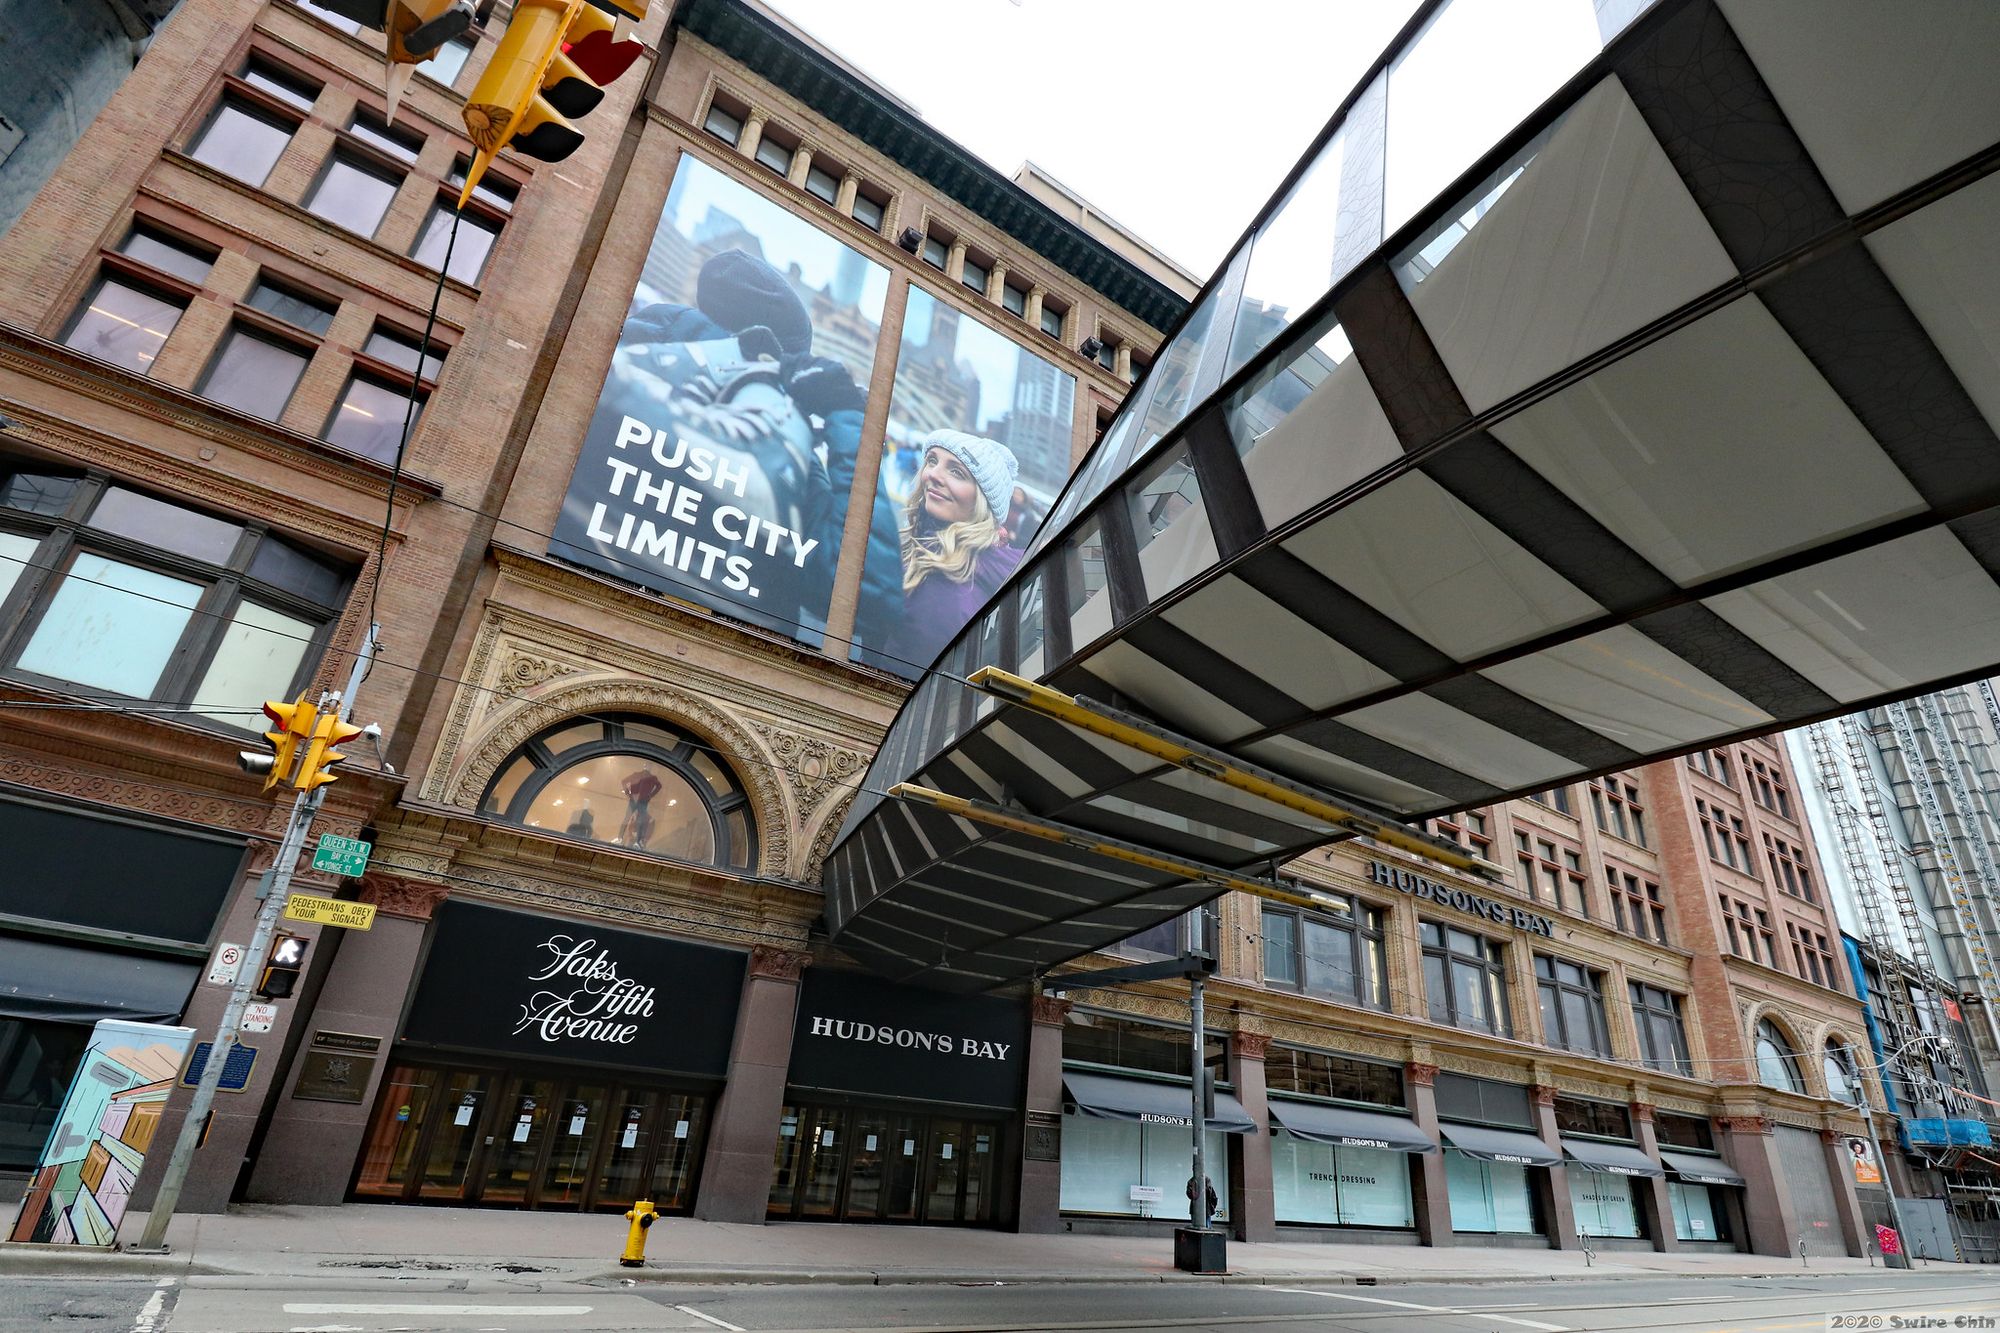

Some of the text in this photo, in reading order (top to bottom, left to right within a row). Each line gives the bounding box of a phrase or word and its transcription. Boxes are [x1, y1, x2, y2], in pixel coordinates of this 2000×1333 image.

[614, 415, 750, 498] PUSH
[606, 456, 819, 568] THE CITY
[586, 501, 760, 598] LIMITS.
[323, 836, 347, 850] QUEEN
[331, 851, 342, 861] BAY
[324, 860, 343, 872] YONGE
[291, 897, 372, 917] PEDESTRIANS OBEY
[1370, 861, 1554, 939] HUDSON'S BAY
[294, 908, 366, 926] YOUR SIGNALS
[528, 934, 618, 981] Saks
[244, 1013, 273, 1024] STANDING
[255, 1005, 268, 1014] NO
[512, 991, 638, 1043] Avenue
[810, 1016, 1010, 1061] HUDSON'S BAY
[1376, 1140, 1389, 1149] BAY
[1341, 1175, 1376, 1185] DRESSING
